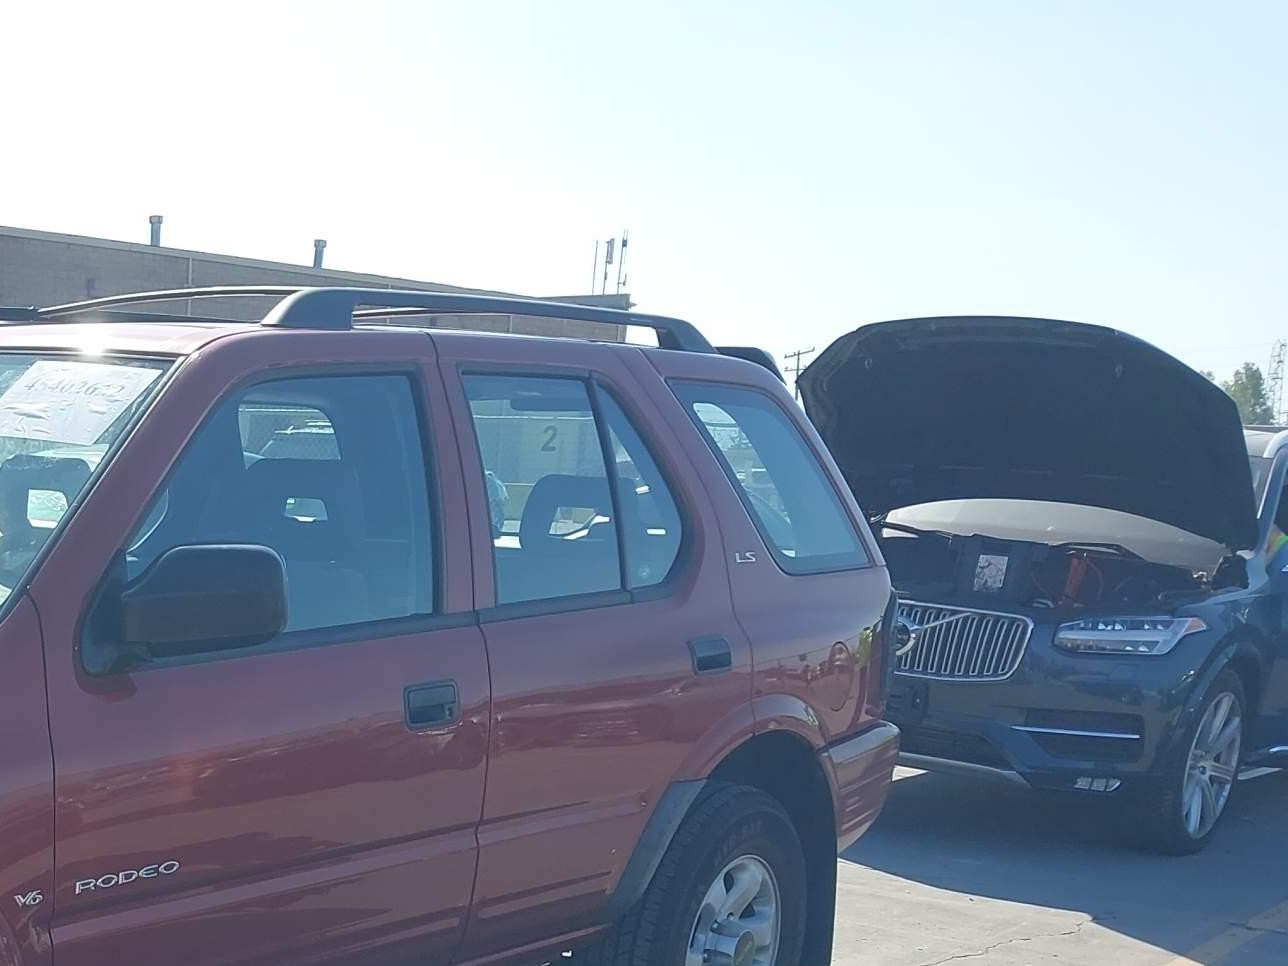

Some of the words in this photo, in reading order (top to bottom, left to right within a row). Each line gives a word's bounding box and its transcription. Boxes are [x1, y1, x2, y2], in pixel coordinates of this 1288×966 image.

[540, 424, 558, 452] 2
[735, 551, 756, 563] LS
[75, 860, 180, 895] RODEO
[14, 889, 43, 908] V6
